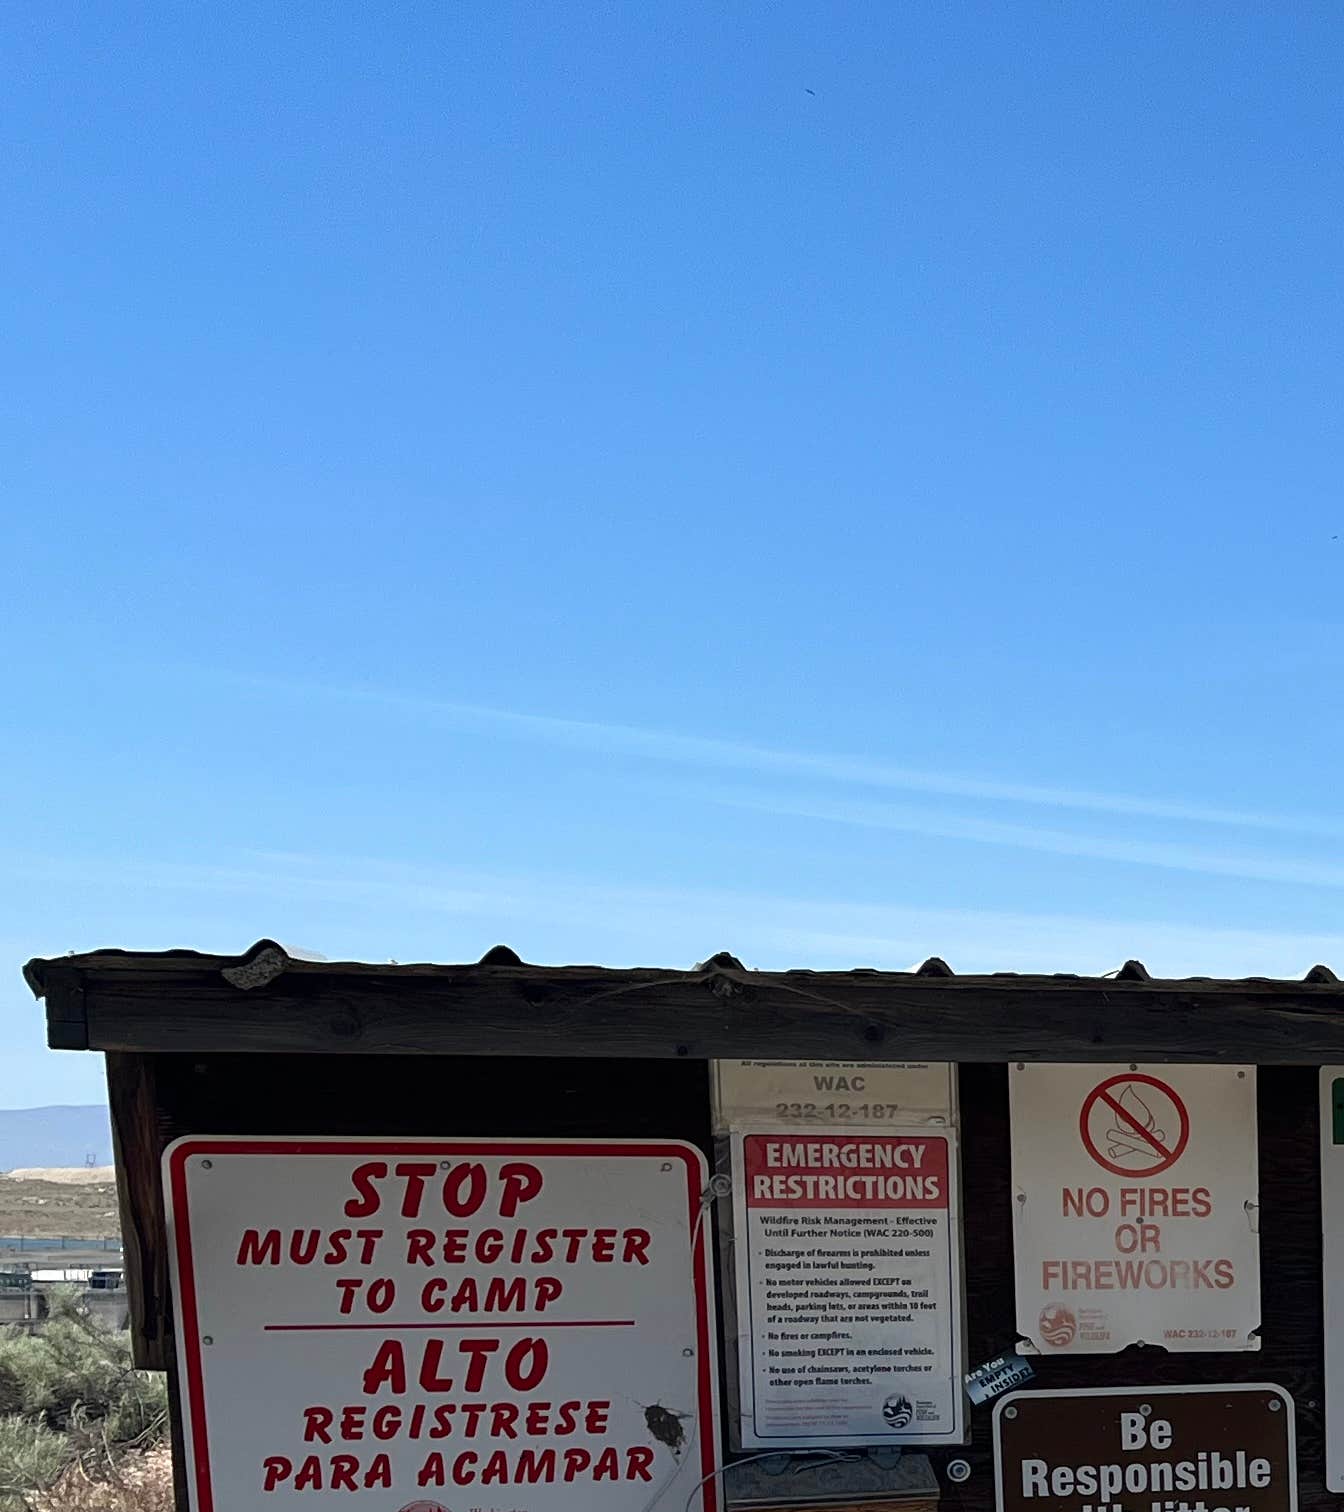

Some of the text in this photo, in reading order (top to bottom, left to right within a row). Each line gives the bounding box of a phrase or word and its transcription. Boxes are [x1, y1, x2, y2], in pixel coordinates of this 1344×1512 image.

[814, 1076, 865, 1092] WAC
[775, 1103, 899, 1120] 232-12-187
[766, 1143, 926, 1169] EMERGENCY
[343, 1160, 544, 1220] STOP
[753, 1174, 941, 1201] RESTRICTIONS
[1061, 1187, 1212, 1218] NO FIRES
[759, 1215, 938, 1228] Wildfire Risk Management Effective
[764, 1228, 789, 1238] Until
[791, 1228, 828, 1238] Further
[830, 1228, 862, 1238] Notice
[863, 1228, 890, 1239] (WAC
[235, 1227, 652, 1267] MUST REGISTER
[1114, 1223, 1162, 1254] OR
[1042, 1259, 1236, 1291] FIREWORKS
[335, 1276, 564, 1315] TO CAMP
[362, 1336, 550, 1396] ALTO
[964, 1357, 1005, 1384] Are You
[978, 1362, 1015, 1389] EMPTY
[302, 1400, 611, 1444] REGISTRESE
[1121, 1412, 1173, 1452] Be
[262, 1446, 656, 1493] PARA ACAMPAR
[1021, 1448, 1272, 1502] Responsible
